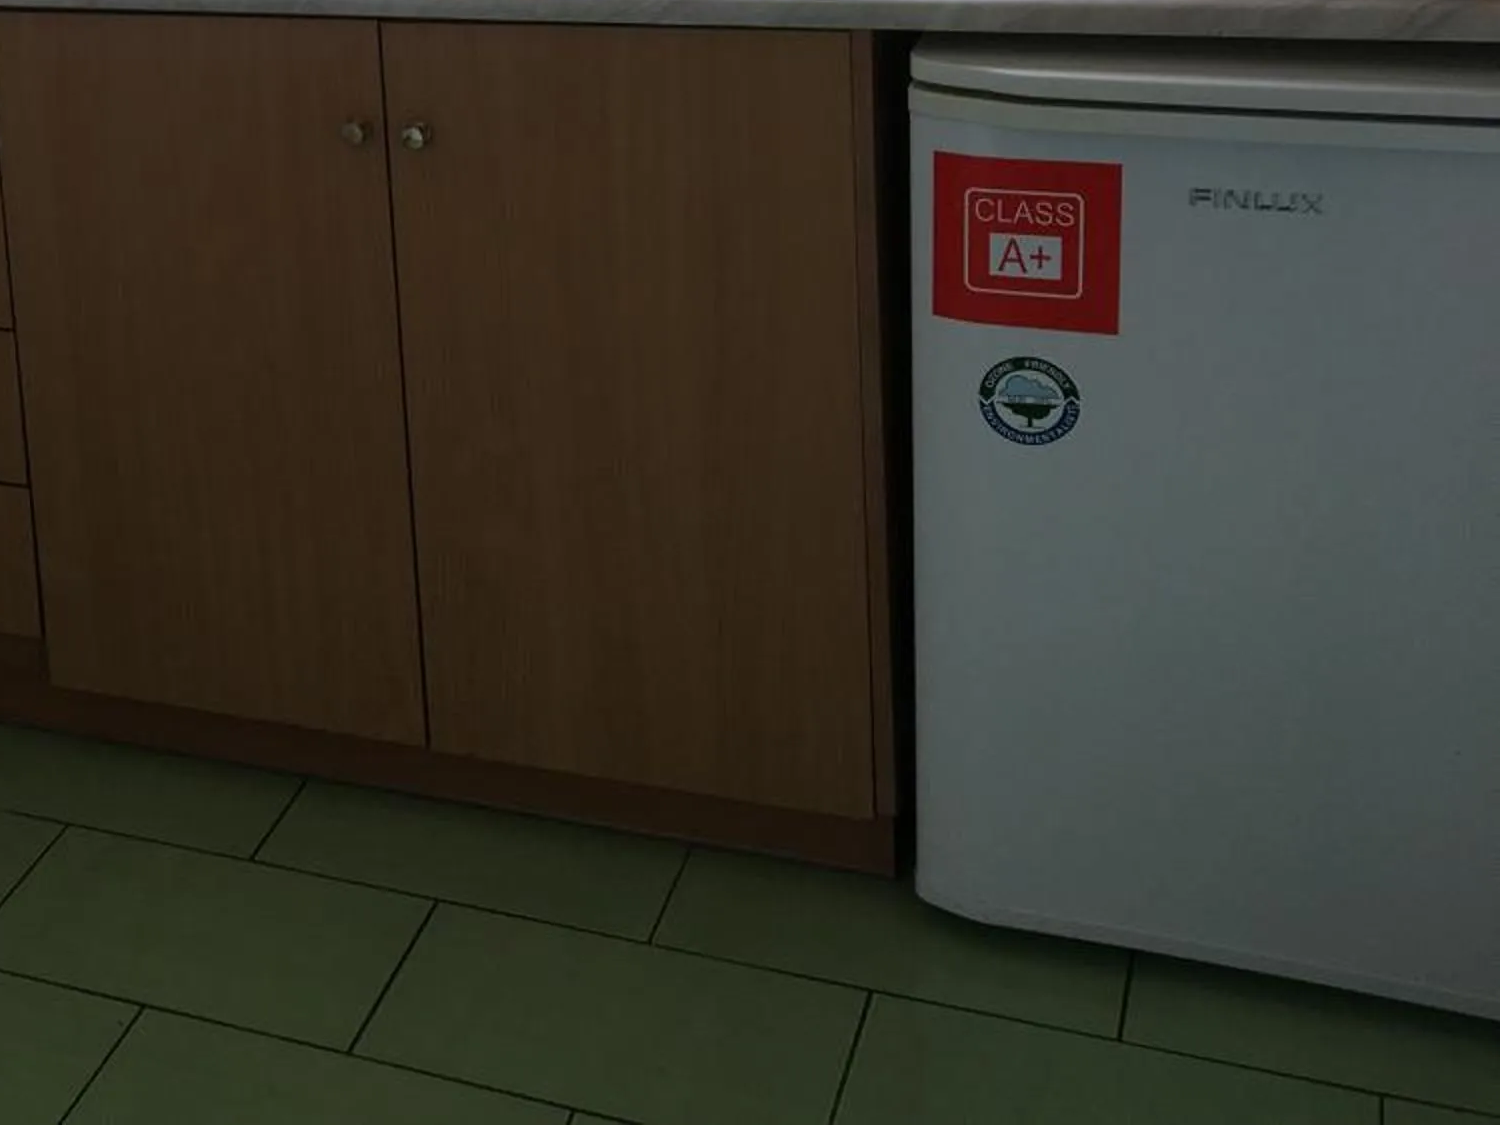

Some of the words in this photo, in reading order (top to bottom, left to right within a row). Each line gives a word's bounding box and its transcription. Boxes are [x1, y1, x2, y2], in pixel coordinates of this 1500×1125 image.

[975, 198, 1075, 227] CLASS
[1188, 187, 1323, 214] FINLUX
[998, 237, 1052, 274] A+
